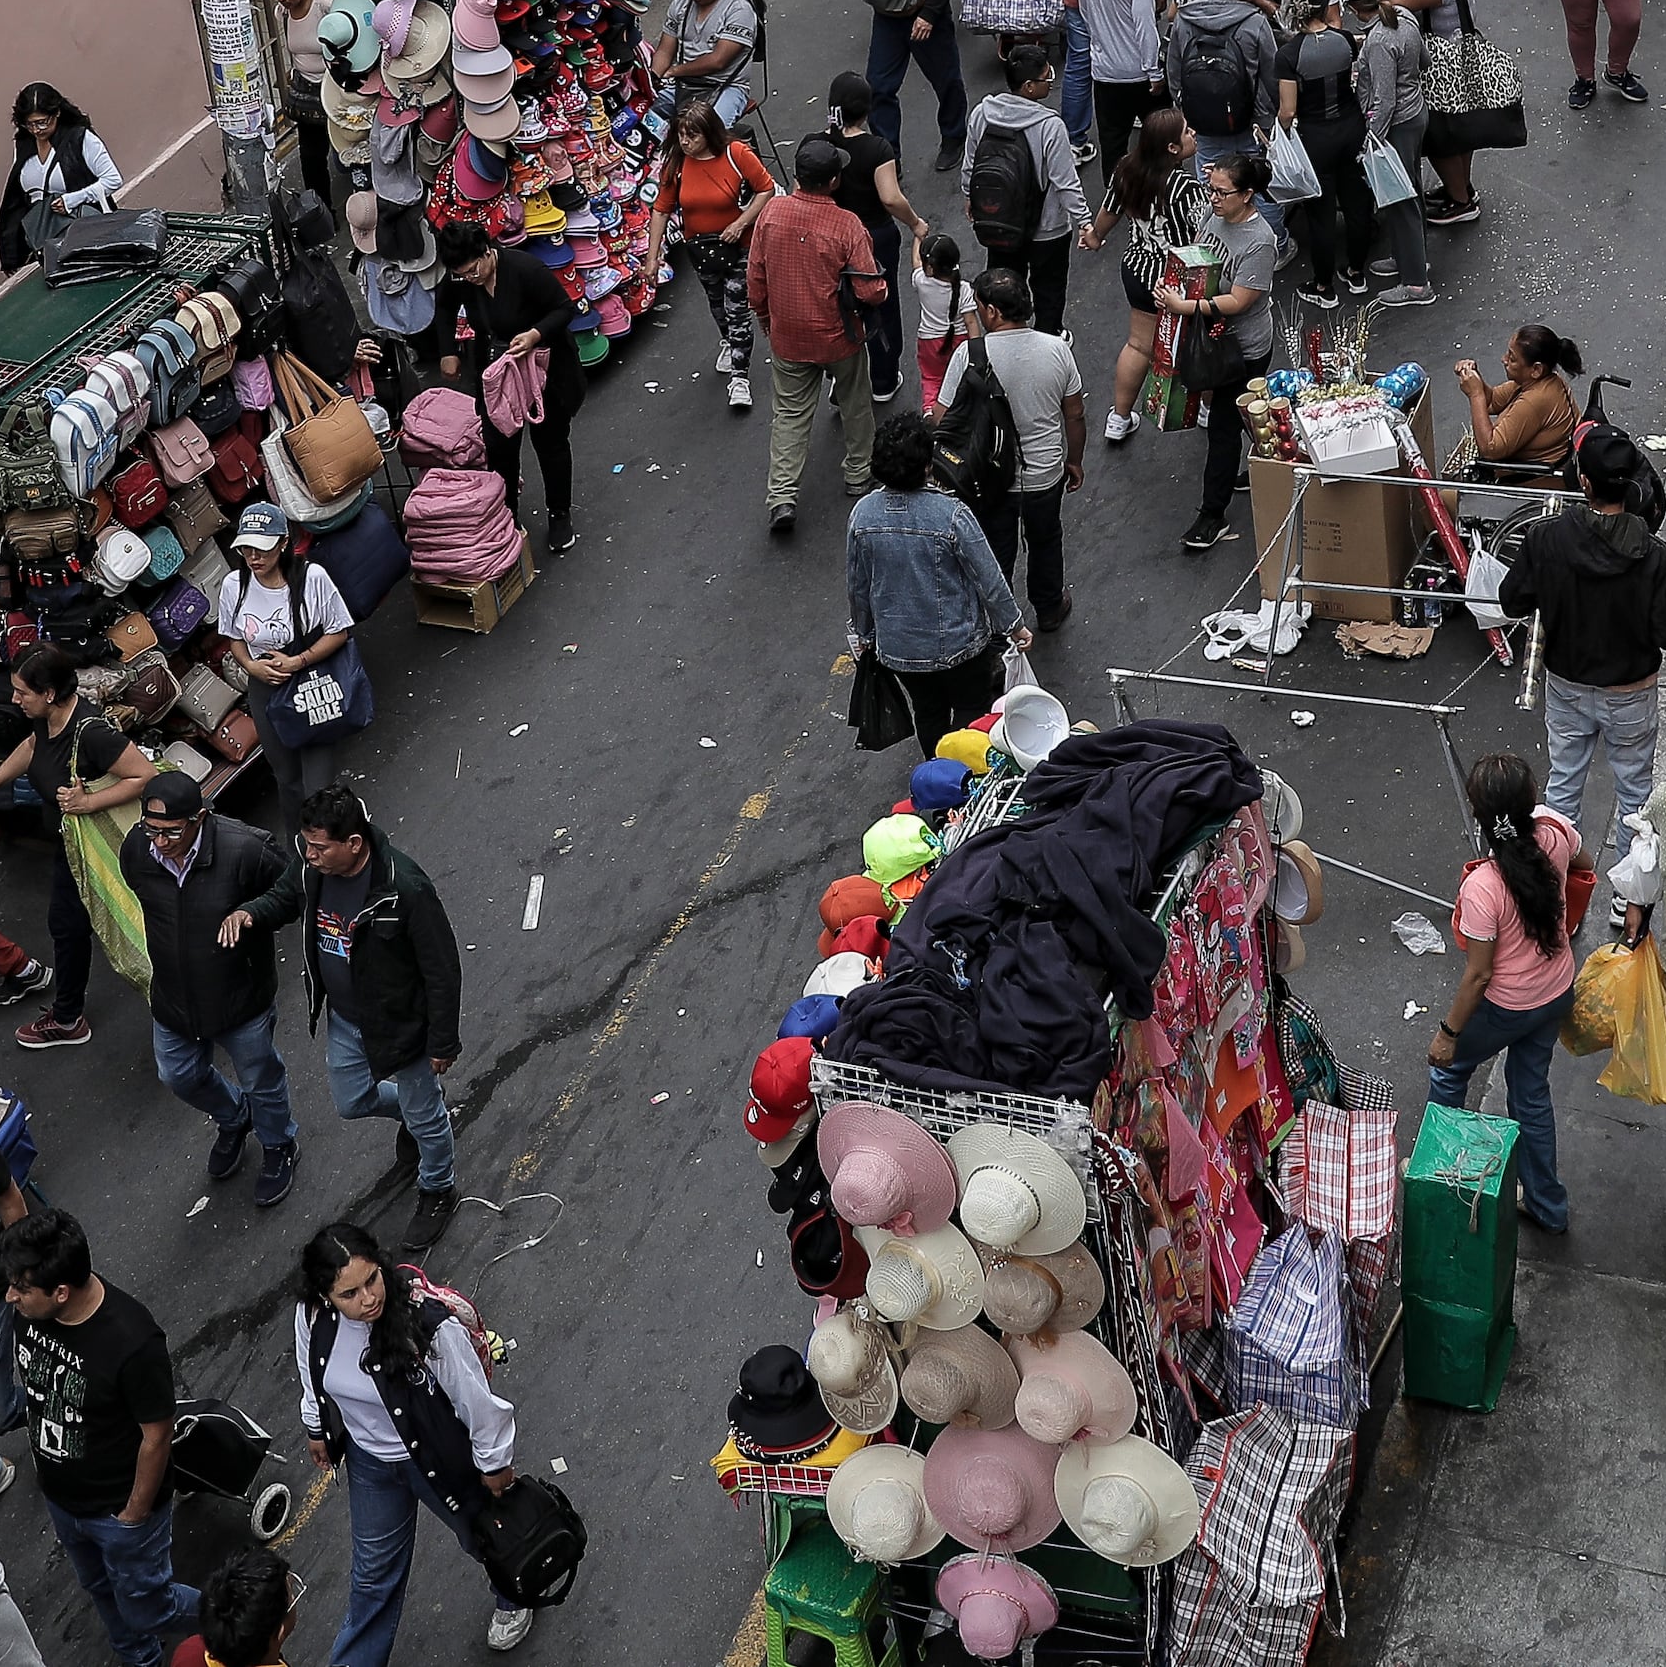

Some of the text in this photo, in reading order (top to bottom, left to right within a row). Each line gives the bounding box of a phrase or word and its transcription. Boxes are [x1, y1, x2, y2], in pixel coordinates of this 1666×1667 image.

[242, 513, 272, 525] BOSTON
[309, 670, 319, 680] TE
[293, 681, 344, 713] SALUD
[308, 701, 342, 726] ABLE
[26, 1324, 84, 1370] MATRIX
